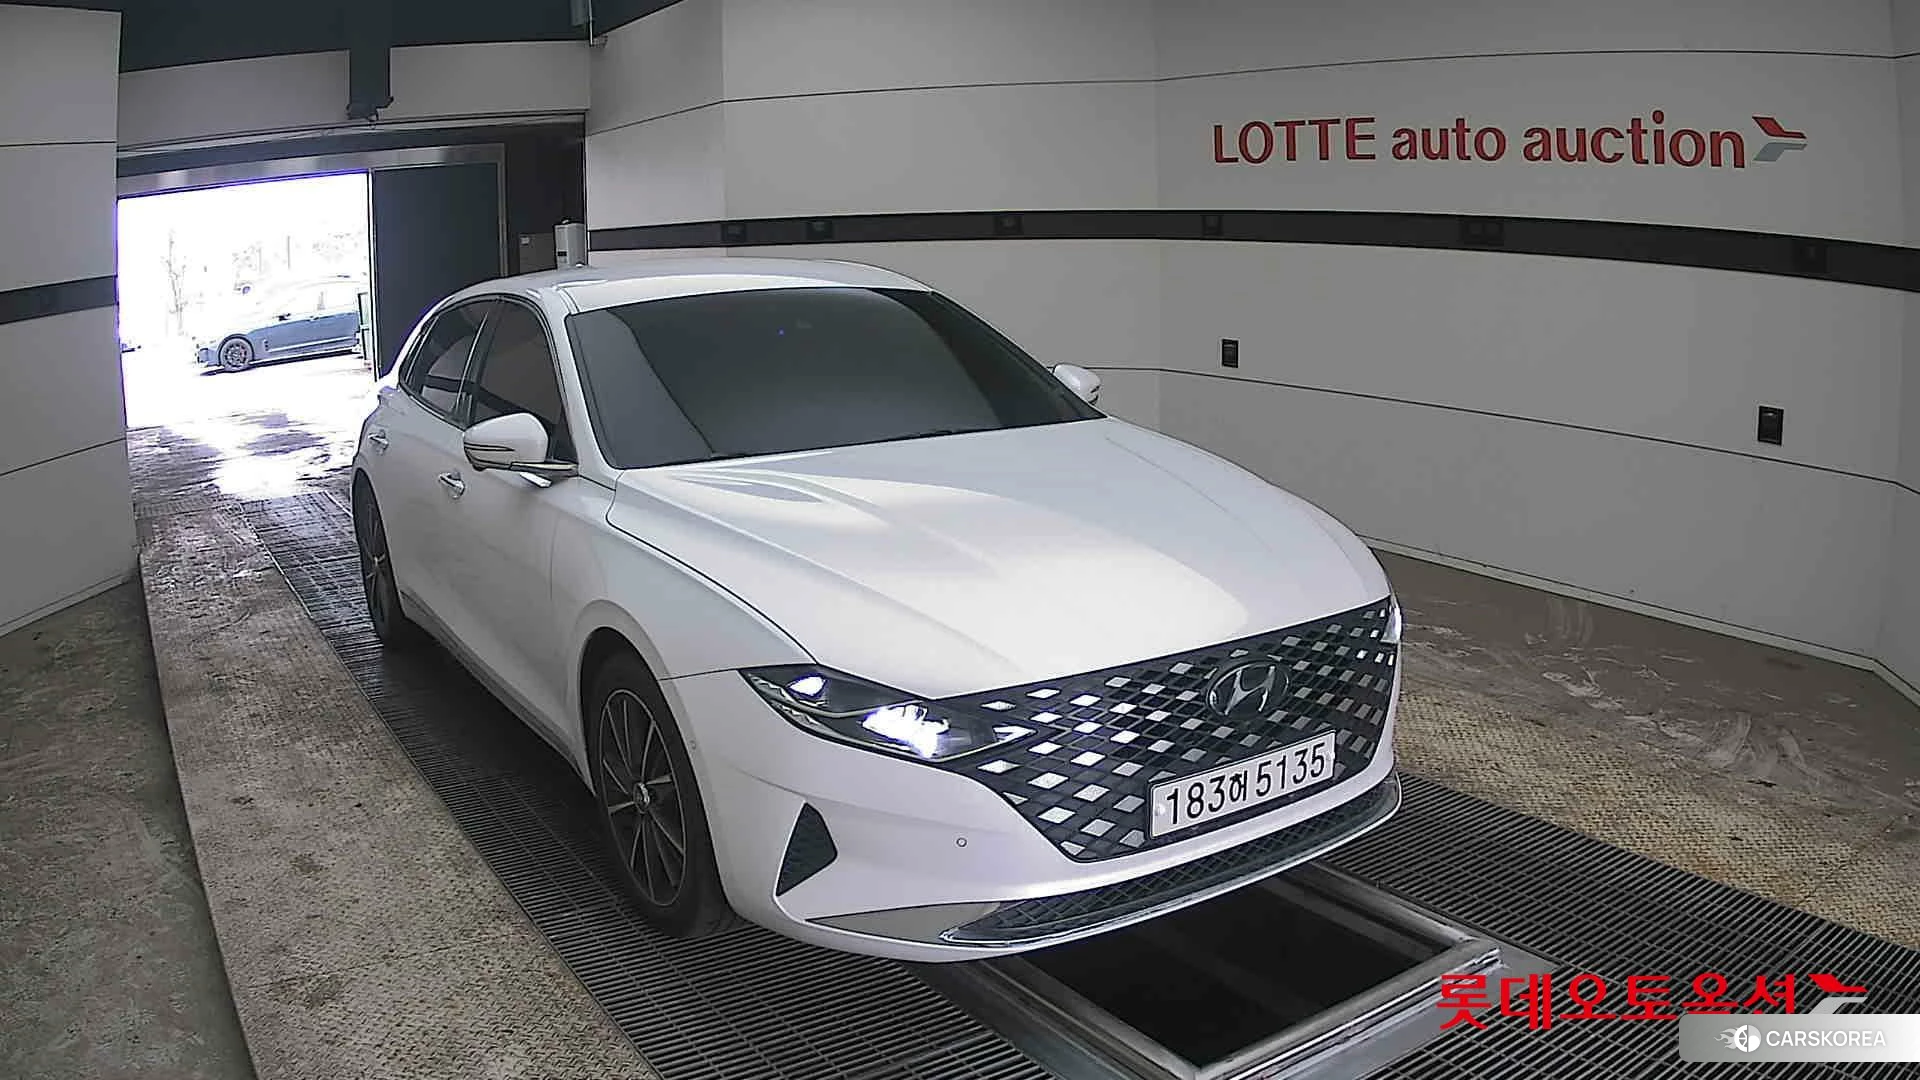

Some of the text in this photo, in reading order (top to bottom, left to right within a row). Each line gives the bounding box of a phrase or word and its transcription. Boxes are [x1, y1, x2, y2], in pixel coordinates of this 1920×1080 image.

[1214, 111, 1745, 168] LOTTE auto auction
[1255, 742, 1326, 797] 5135
